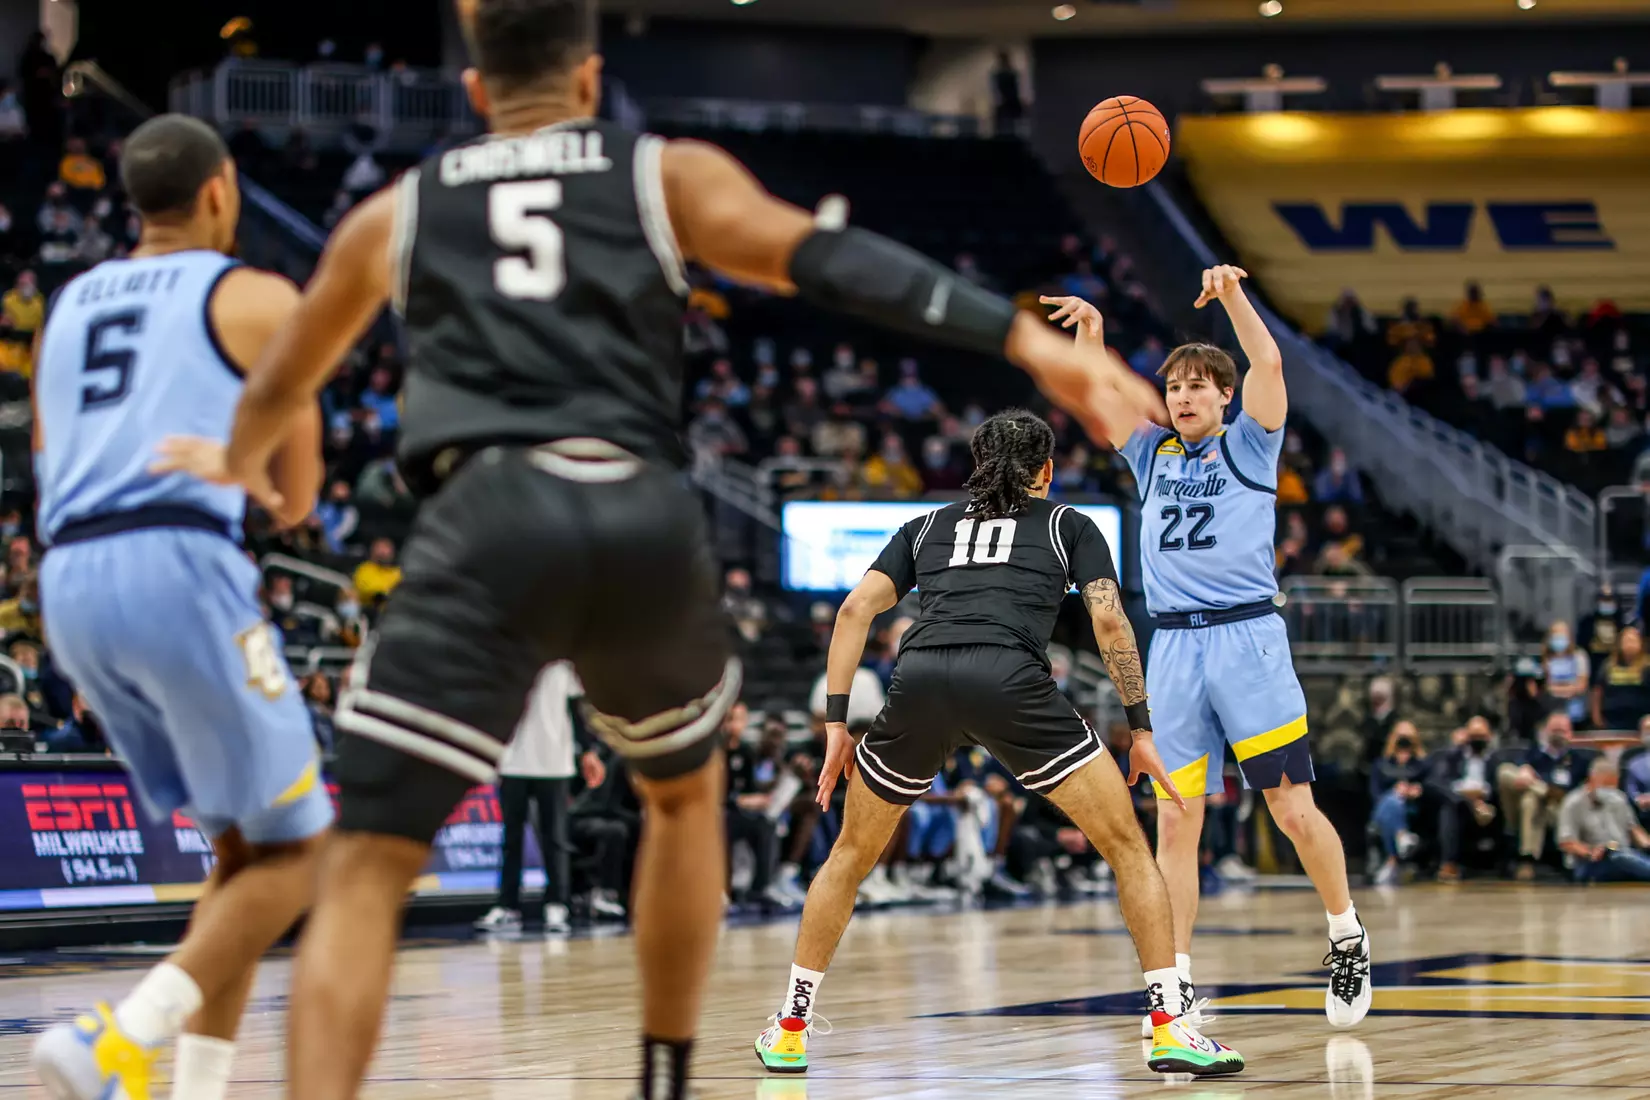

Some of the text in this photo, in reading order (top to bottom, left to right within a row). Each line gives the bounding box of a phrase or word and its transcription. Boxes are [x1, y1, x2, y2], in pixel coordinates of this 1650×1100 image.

[489, 178, 567, 301] 5
[1272, 199, 1617, 252] WE
[79, 303, 148, 414] 5
[1153, 472, 1227, 502] Marquette
[948, 517, 1018, 568] 10
[1159, 503, 1217, 552] 22
[20, 784, 138, 831] ESPN
[31, 829, 144, 858] MILWAUKEE
